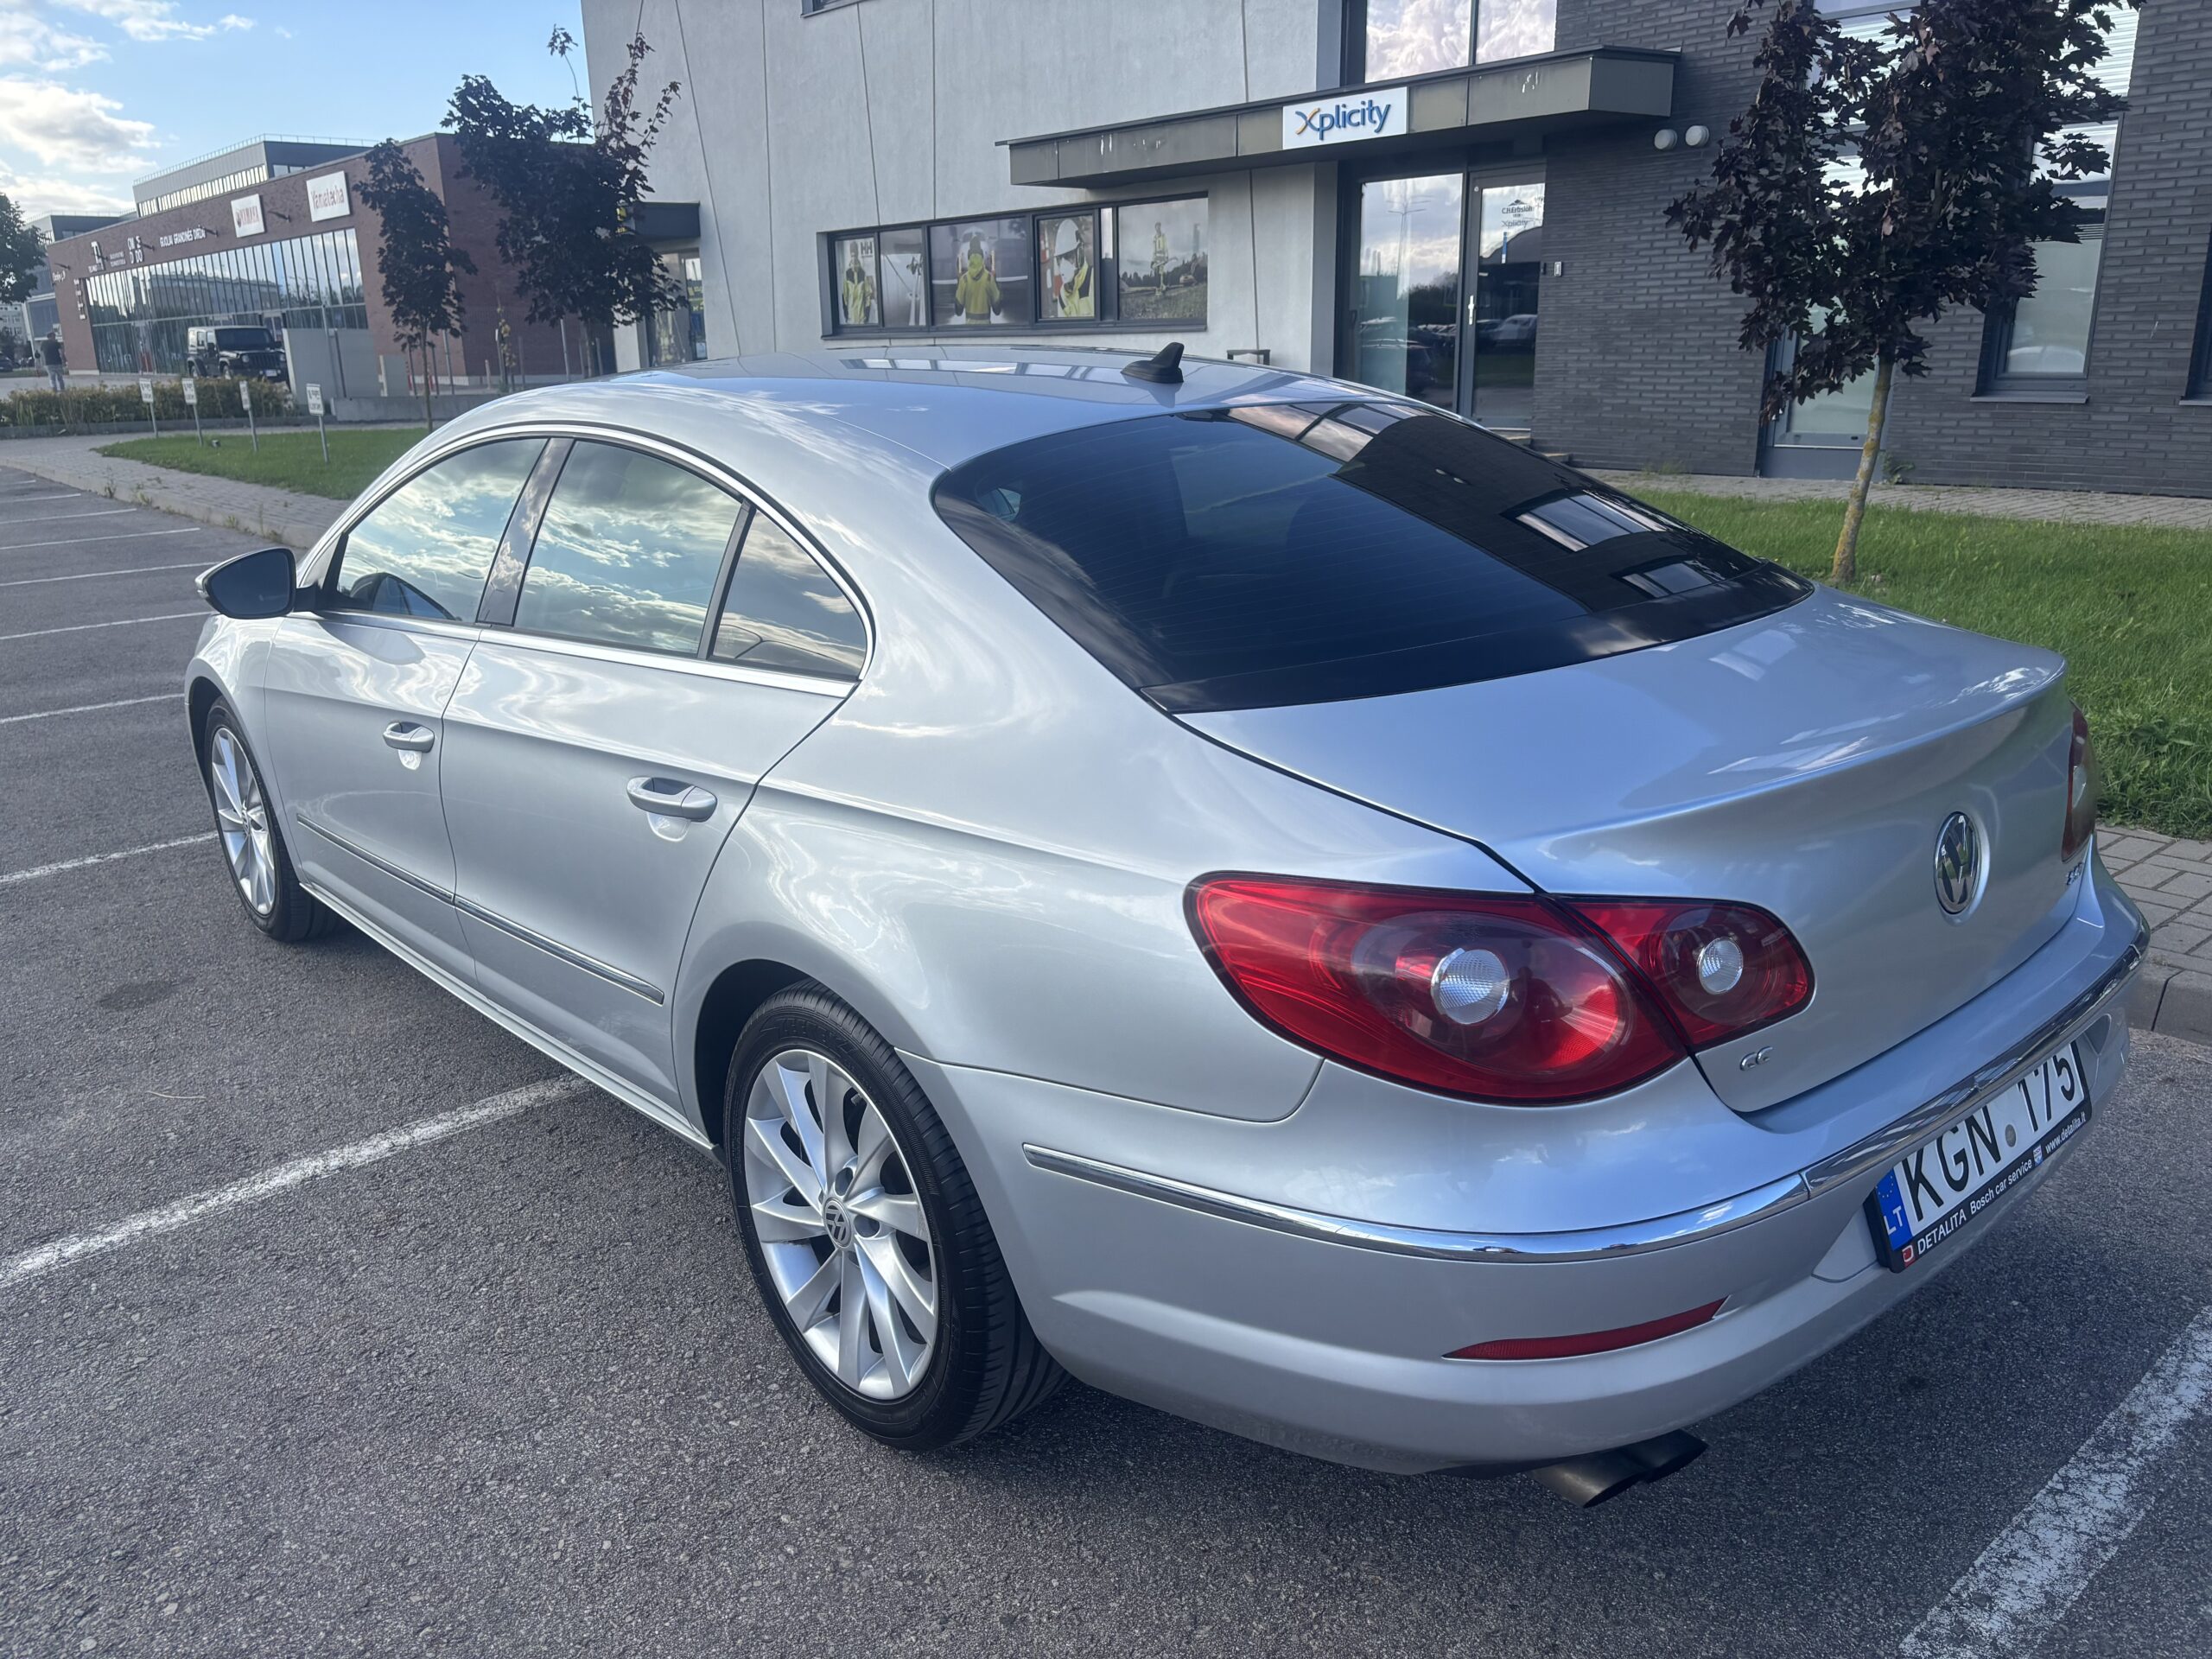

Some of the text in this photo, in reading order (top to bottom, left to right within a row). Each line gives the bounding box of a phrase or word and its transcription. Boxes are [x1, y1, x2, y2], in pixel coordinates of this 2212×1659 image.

[1295, 99, 1391, 141] Xplicity
[1901, 1054, 2075, 1222] KGN 175
[1917, 1209, 1967, 1255] DETALITA
[1970, 1189, 1994, 1214] Bosch
[1995, 1178, 2007, 1196] car
[2007, 1159, 2032, 1185] service
[2045, 1111, 2087, 1154] www.detalita.lt
[1884, 1205, 1904, 1236] LT
